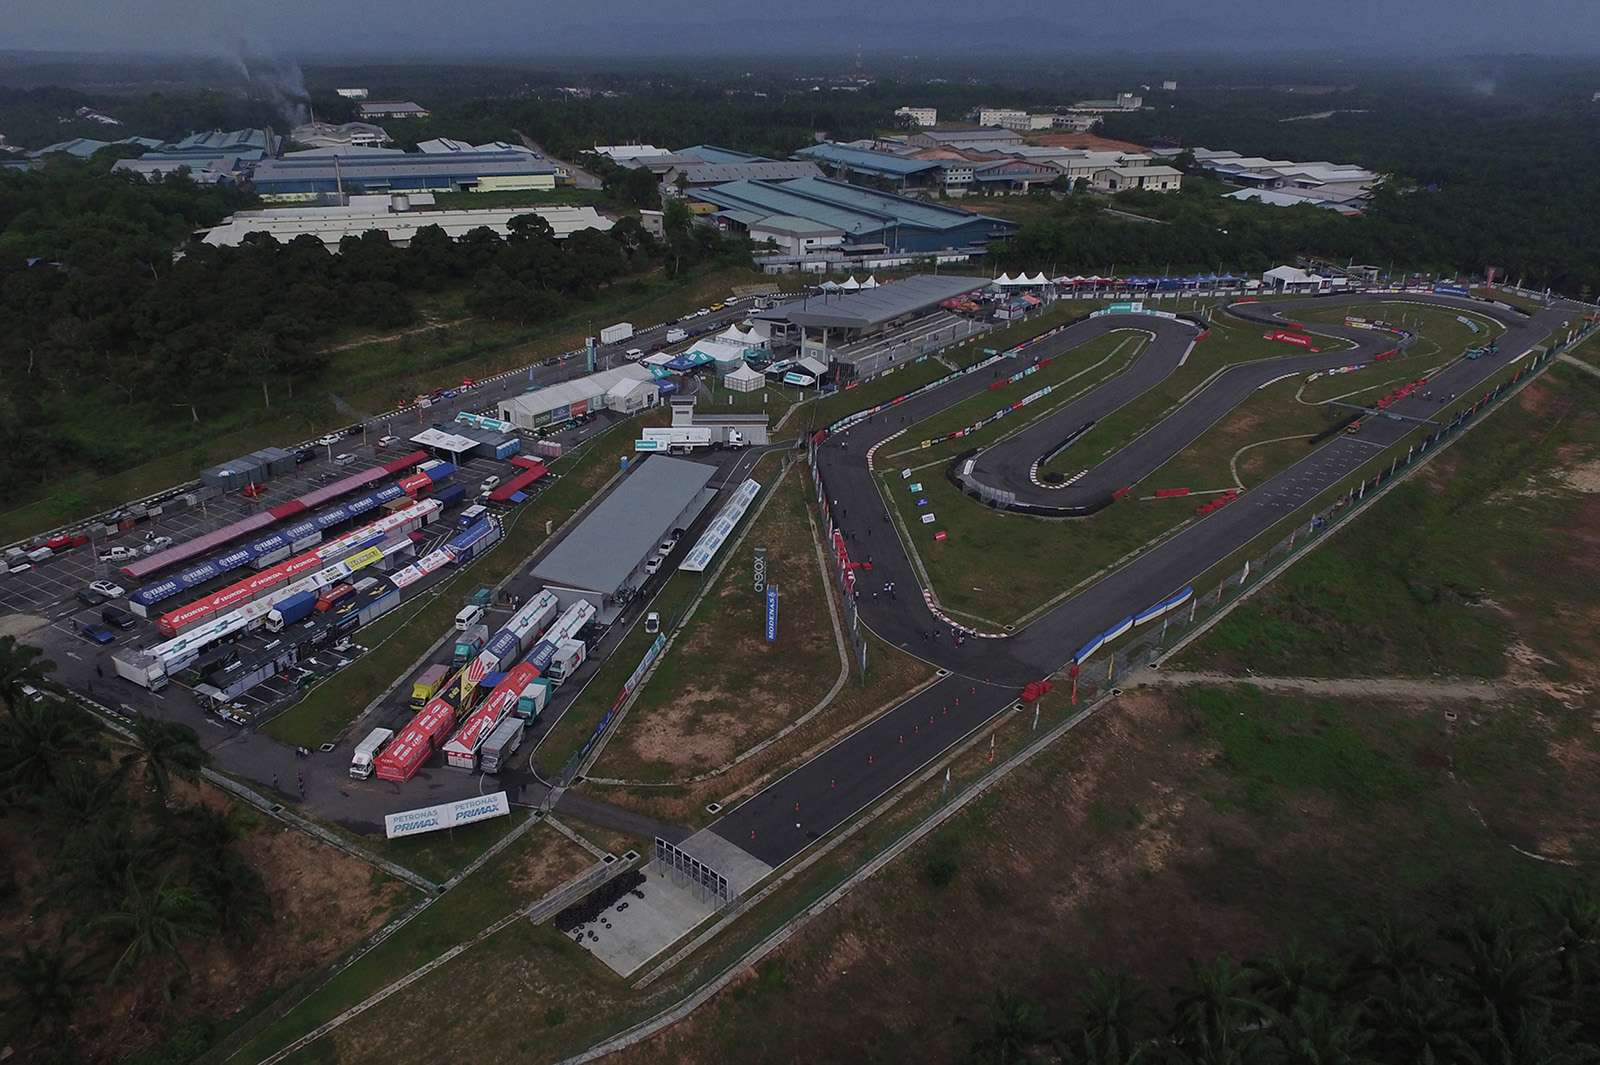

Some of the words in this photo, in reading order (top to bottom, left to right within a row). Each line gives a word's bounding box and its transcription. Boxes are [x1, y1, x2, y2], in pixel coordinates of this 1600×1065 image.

[1283, 336, 1307, 345] HONDA
[382, 486, 400, 498] YAMAHA
[354, 498, 373, 510] YAMAHA
[324, 510, 344, 522] YAMAHA
[293, 522, 314, 535] YAMAHA
[261, 536, 282, 549] YAMAHA
[225, 550, 250, 565] YAMAHA
[293, 557, 317, 570] HONDA
[188, 566, 214, 581] YAMAHA
[258, 573, 283, 585] HONDA
[150, 581, 177, 596] YAMAHA
[221, 588, 247, 602] HONDA
[180, 605, 209, 620] HONDA
[491, 691, 507, 708] HONDA
[466, 718, 483, 736] HONDA
[455, 796, 498, 811] PETRONAS
[393, 809, 438, 823] PETRONAS
[455, 804, 500, 821] PRIMAX
[393, 818, 439, 833] PRIMAX
